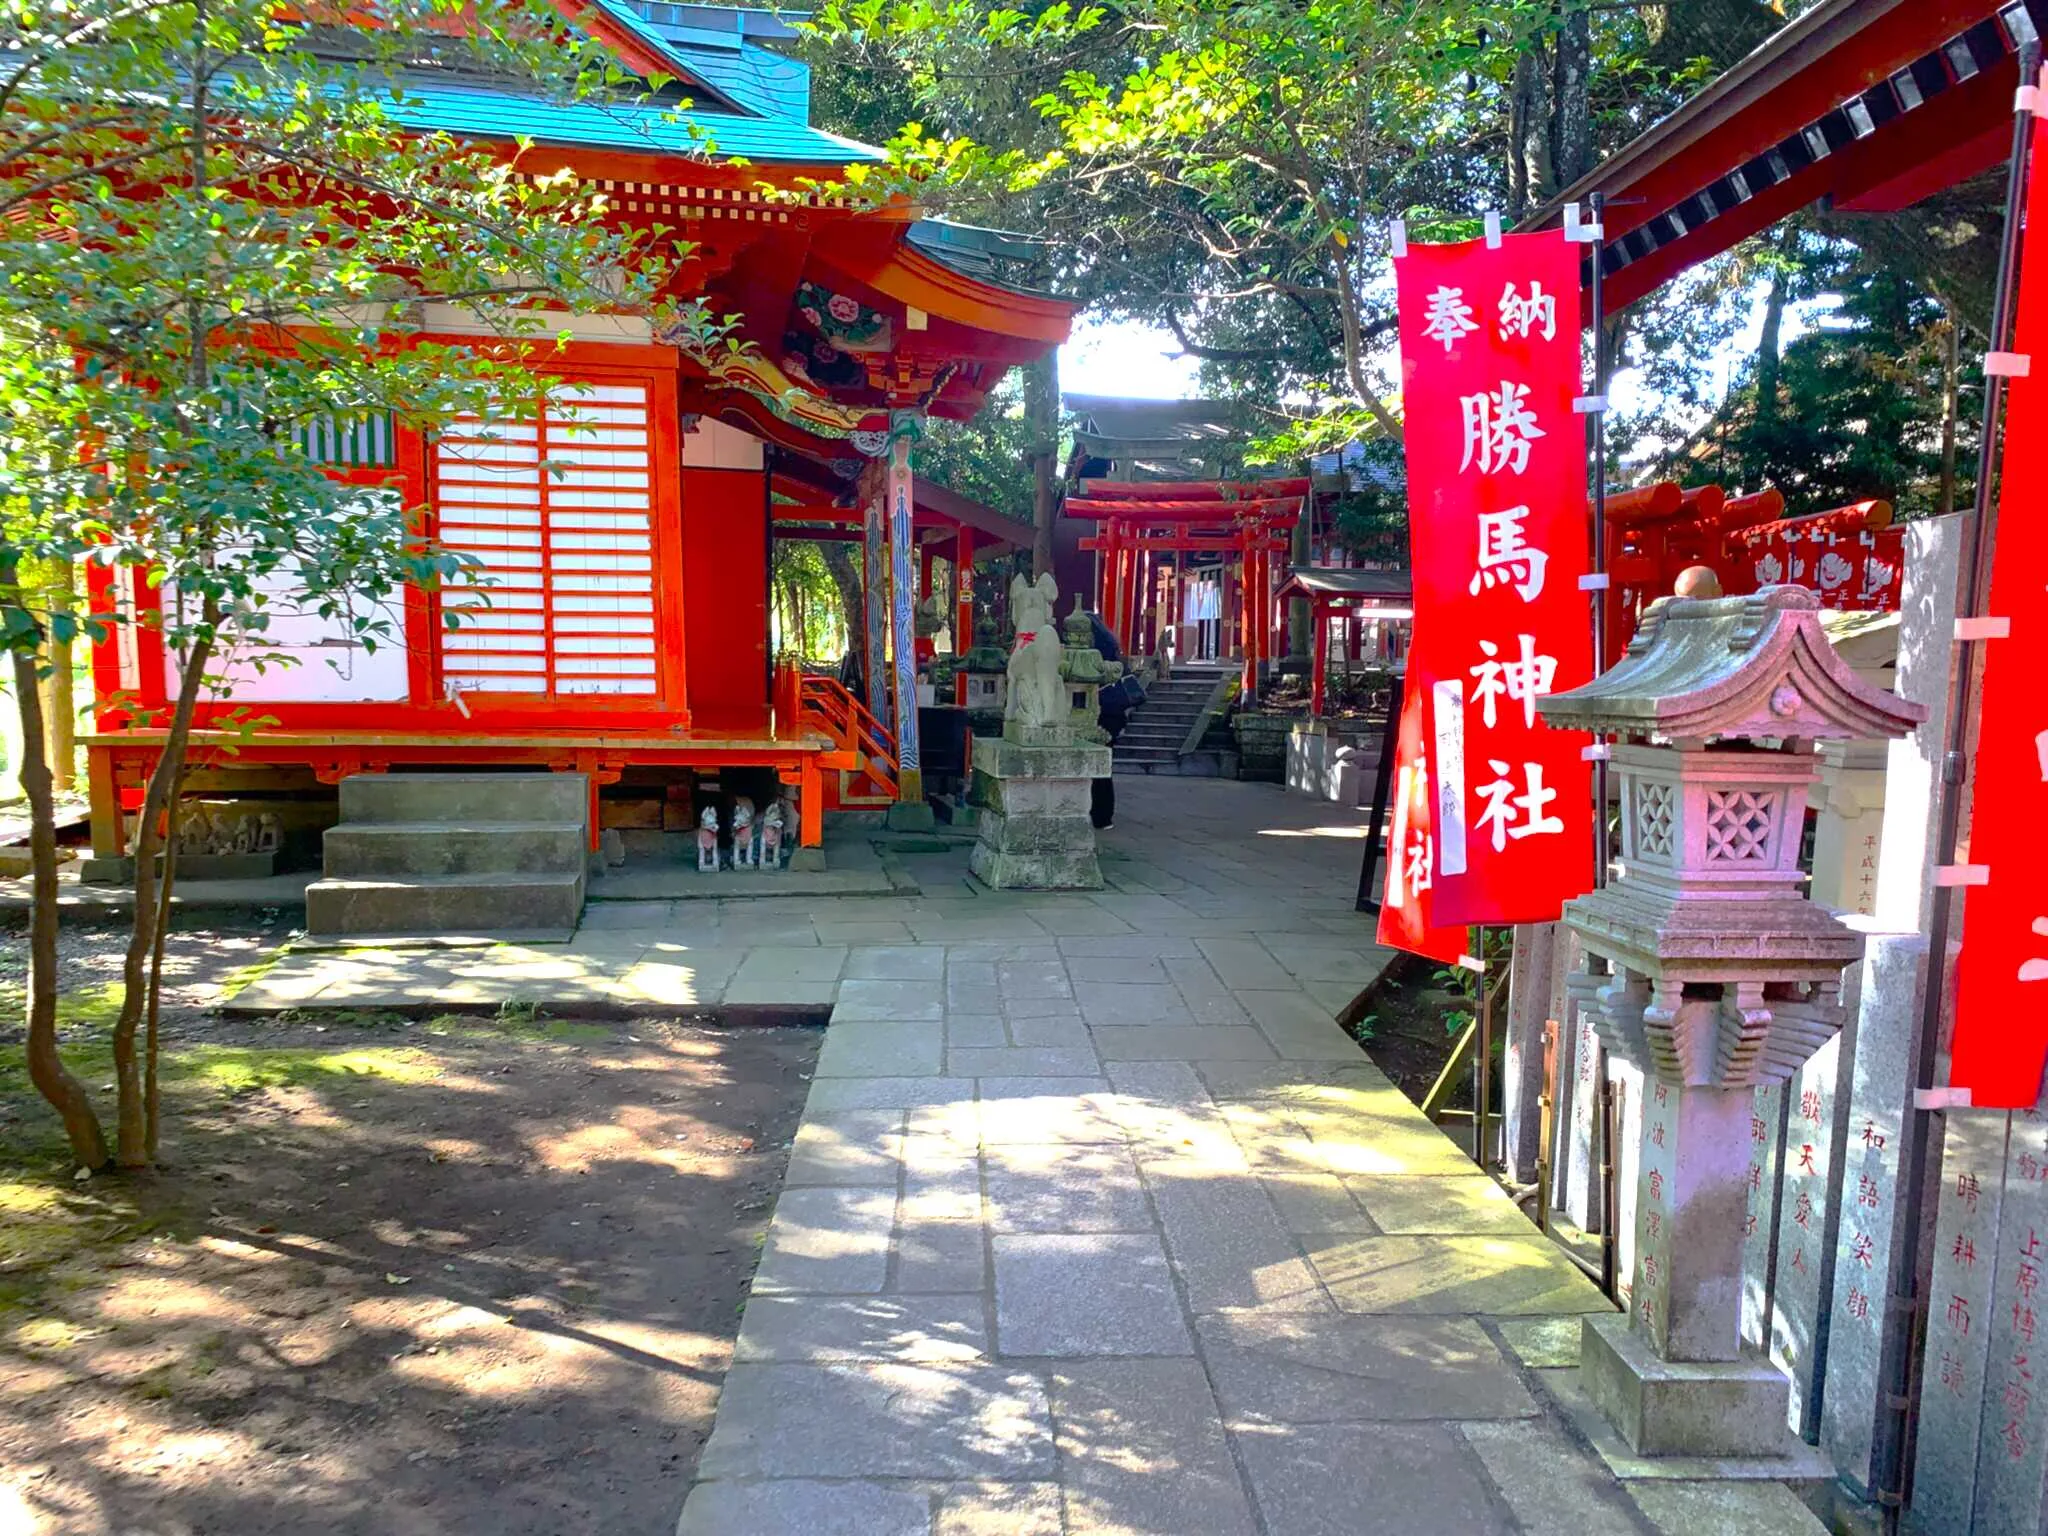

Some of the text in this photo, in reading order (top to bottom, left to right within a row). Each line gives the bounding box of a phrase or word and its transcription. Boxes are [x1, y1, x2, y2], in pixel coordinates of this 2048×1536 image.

[1420, 281, 1557, 352] 奉納
[1459, 379, 1565, 854] 勝馬神社
[1791, 1090, 1821, 1274] 敬天愛人
[1847, 1120, 1886, 1319] 和語笑顔
